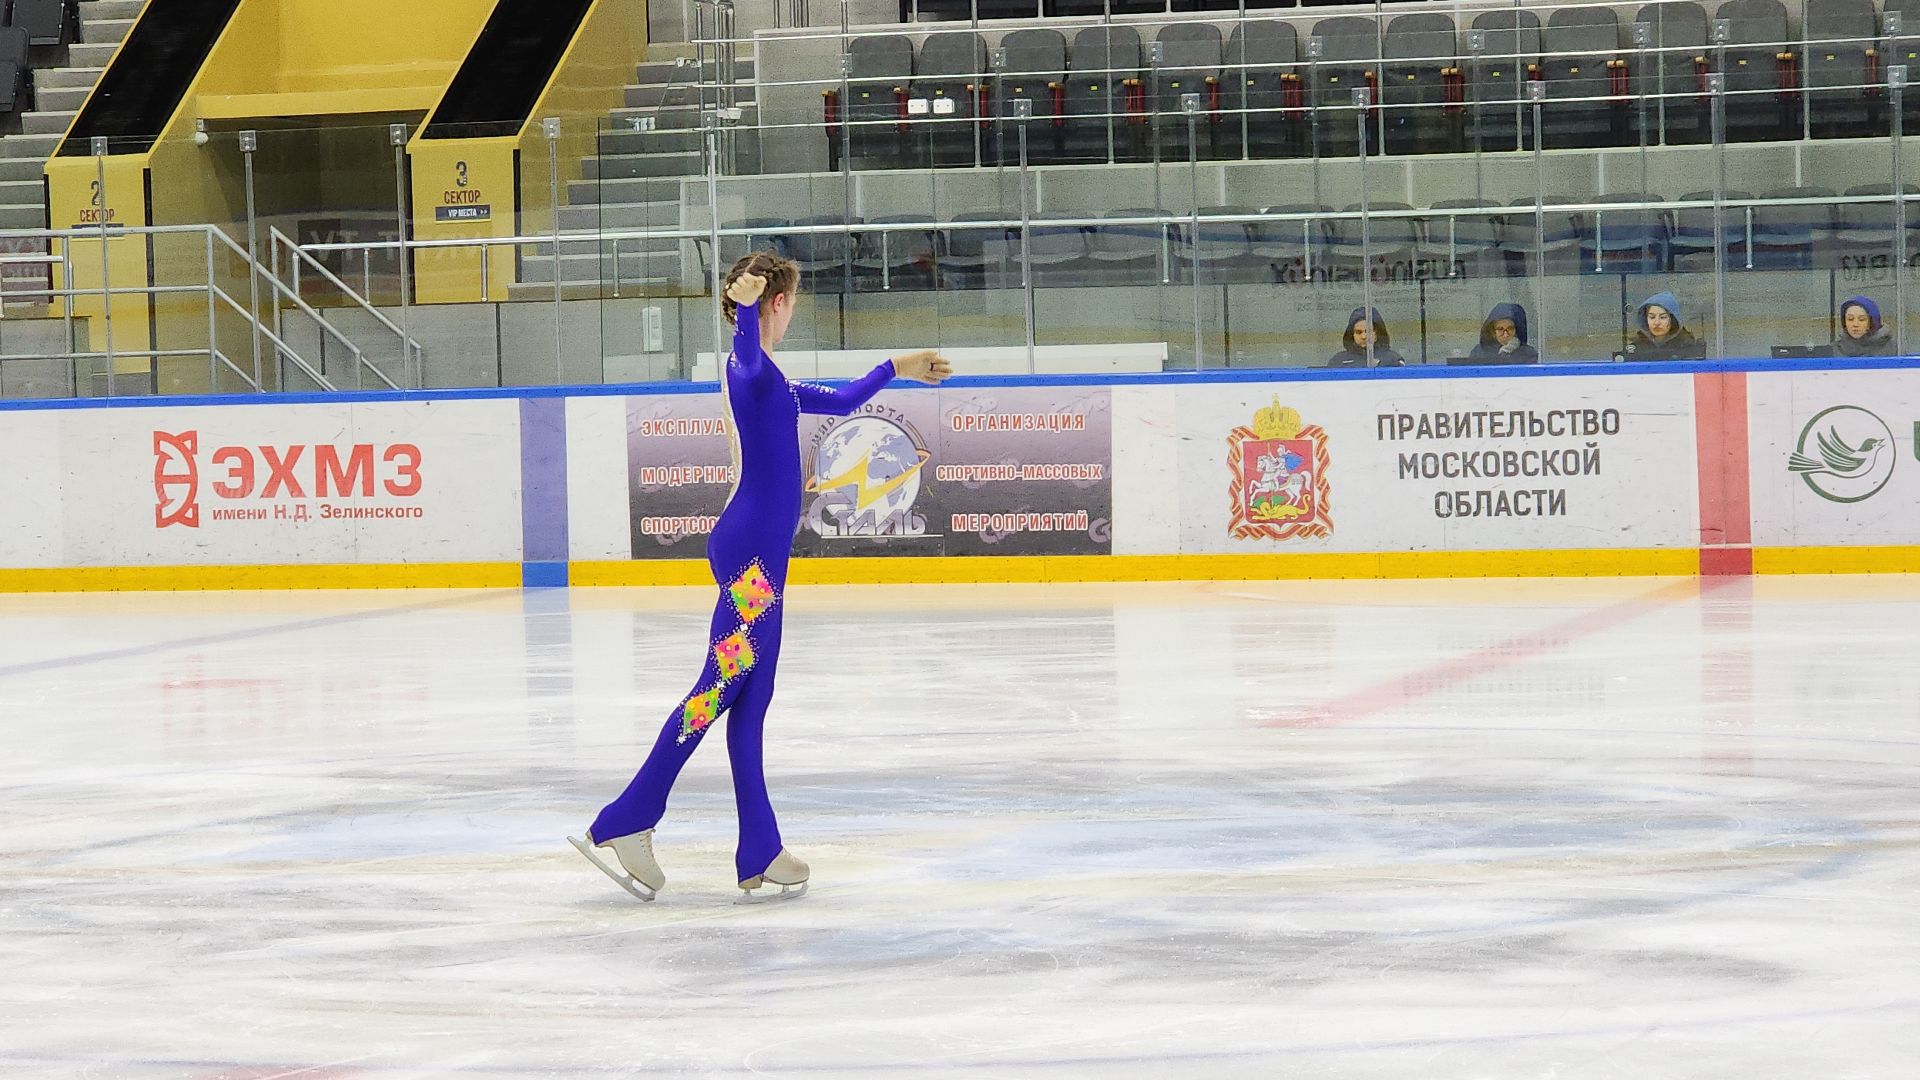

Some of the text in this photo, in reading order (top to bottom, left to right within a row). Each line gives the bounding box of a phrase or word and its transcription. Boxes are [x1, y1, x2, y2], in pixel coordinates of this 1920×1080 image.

[455, 160, 468, 187] 3
[90, 180, 101, 206] 2
[443, 189, 481, 205] СЕКТОР
[951, 413, 1086, 434] ОРГАНИЗАЦИЯ
[1377, 408, 1621, 441] ПРАВИТЕЛЬСТВО
[211, 443, 423, 499] ЭХМЗ
[936, 463, 1103, 481] СПОРТИВНО-МАССОВЫХ
[1398, 441, 1602, 480] МОСКОВСКОЙ
[211, 503, 424, 522] имени Н.Д. Зелинского
[1433, 488, 1567, 519] ОБЛАСТИ
[951, 509, 1089, 532] МЕРОПРИЯТИЙ
